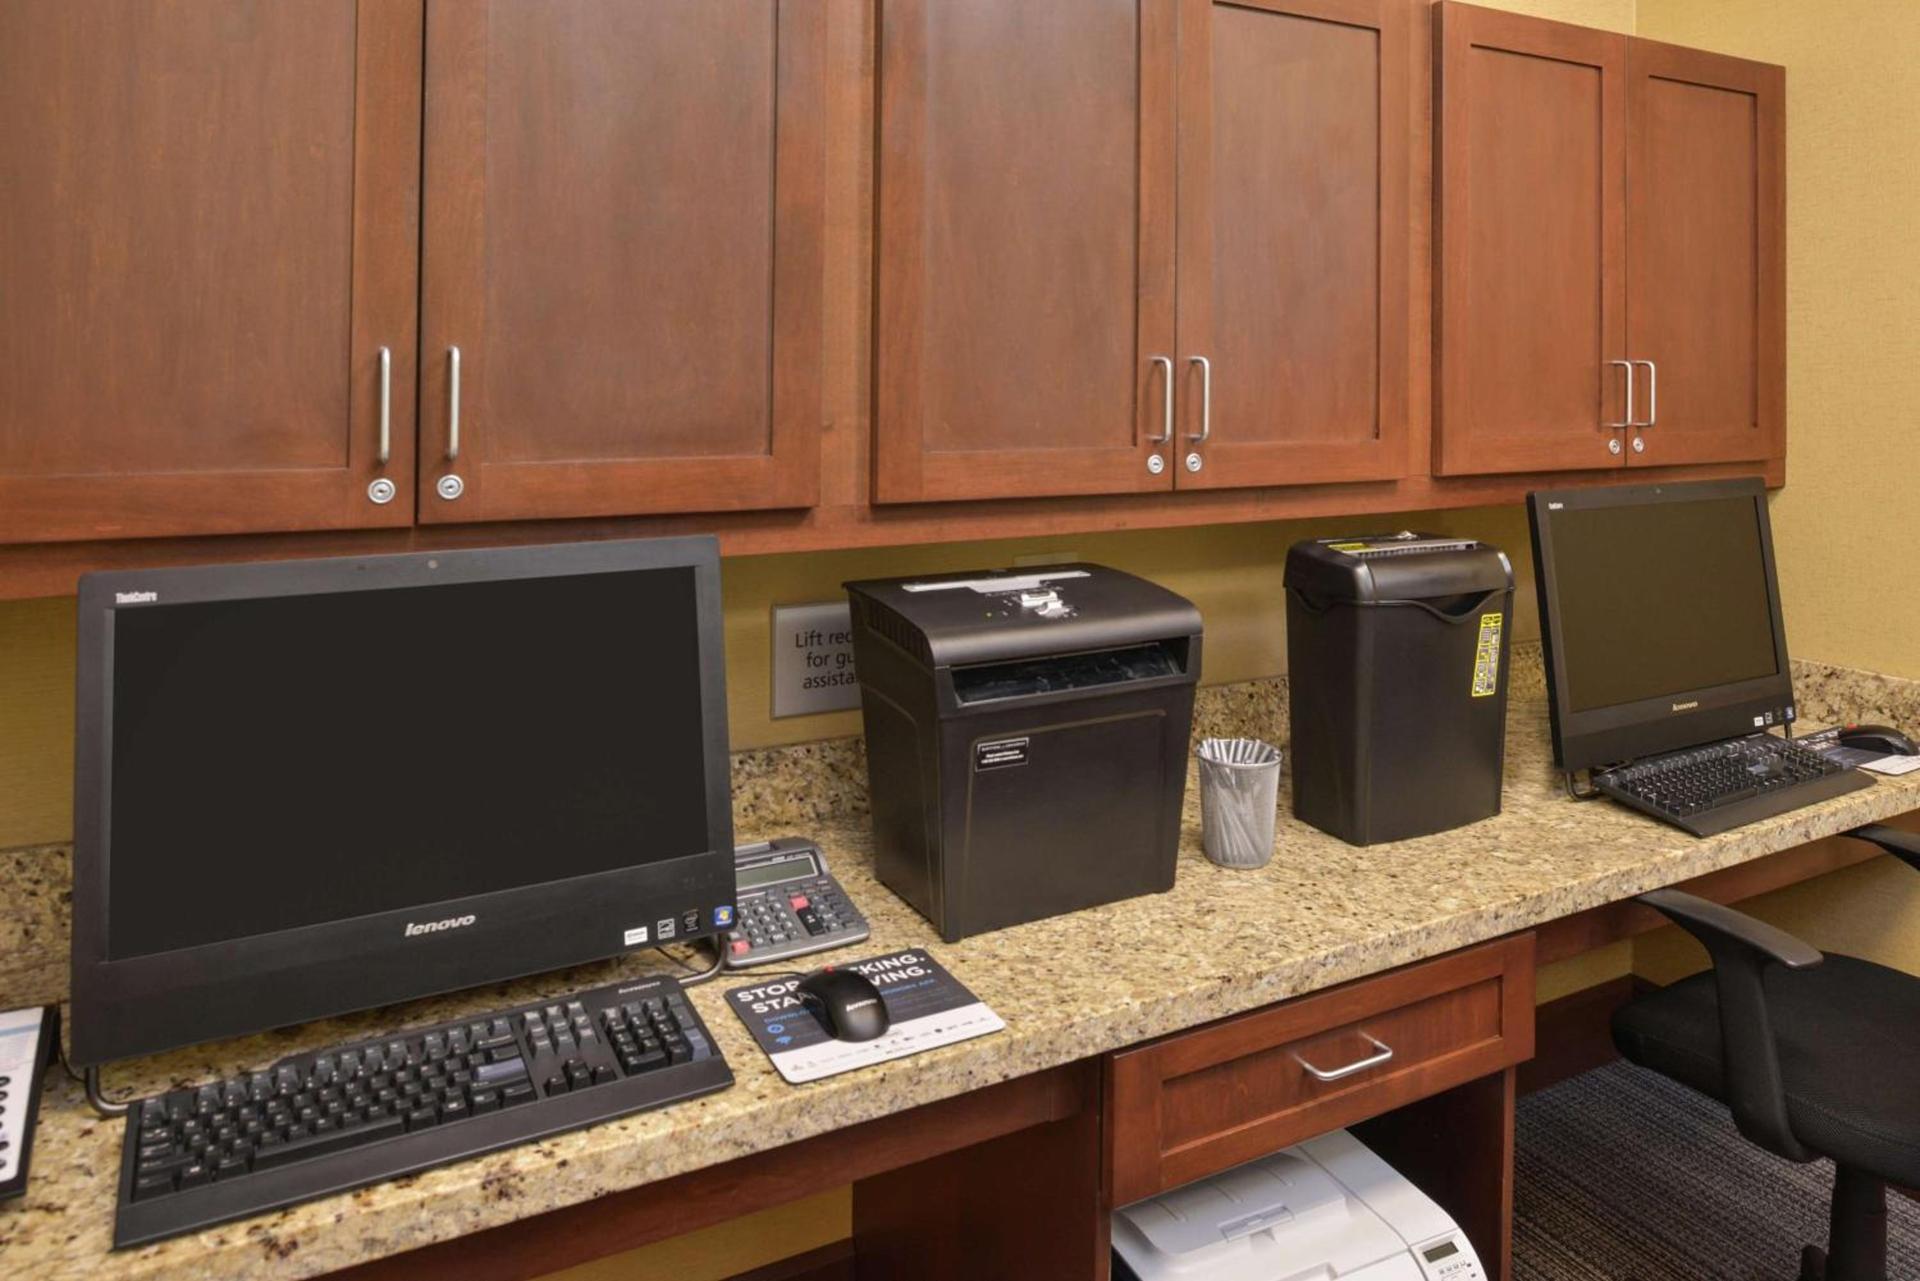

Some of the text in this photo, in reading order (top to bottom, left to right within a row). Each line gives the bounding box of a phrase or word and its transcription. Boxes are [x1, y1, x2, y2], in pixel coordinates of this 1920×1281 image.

[795, 630, 822, 648] Lift
[805, 652, 830, 668] for
[802, 671, 855, 690] assista
[404, 915, 477, 937] lenovo
[737, 954, 926, 1002] STOP KING.
[751, 992, 818, 1013] STAR
